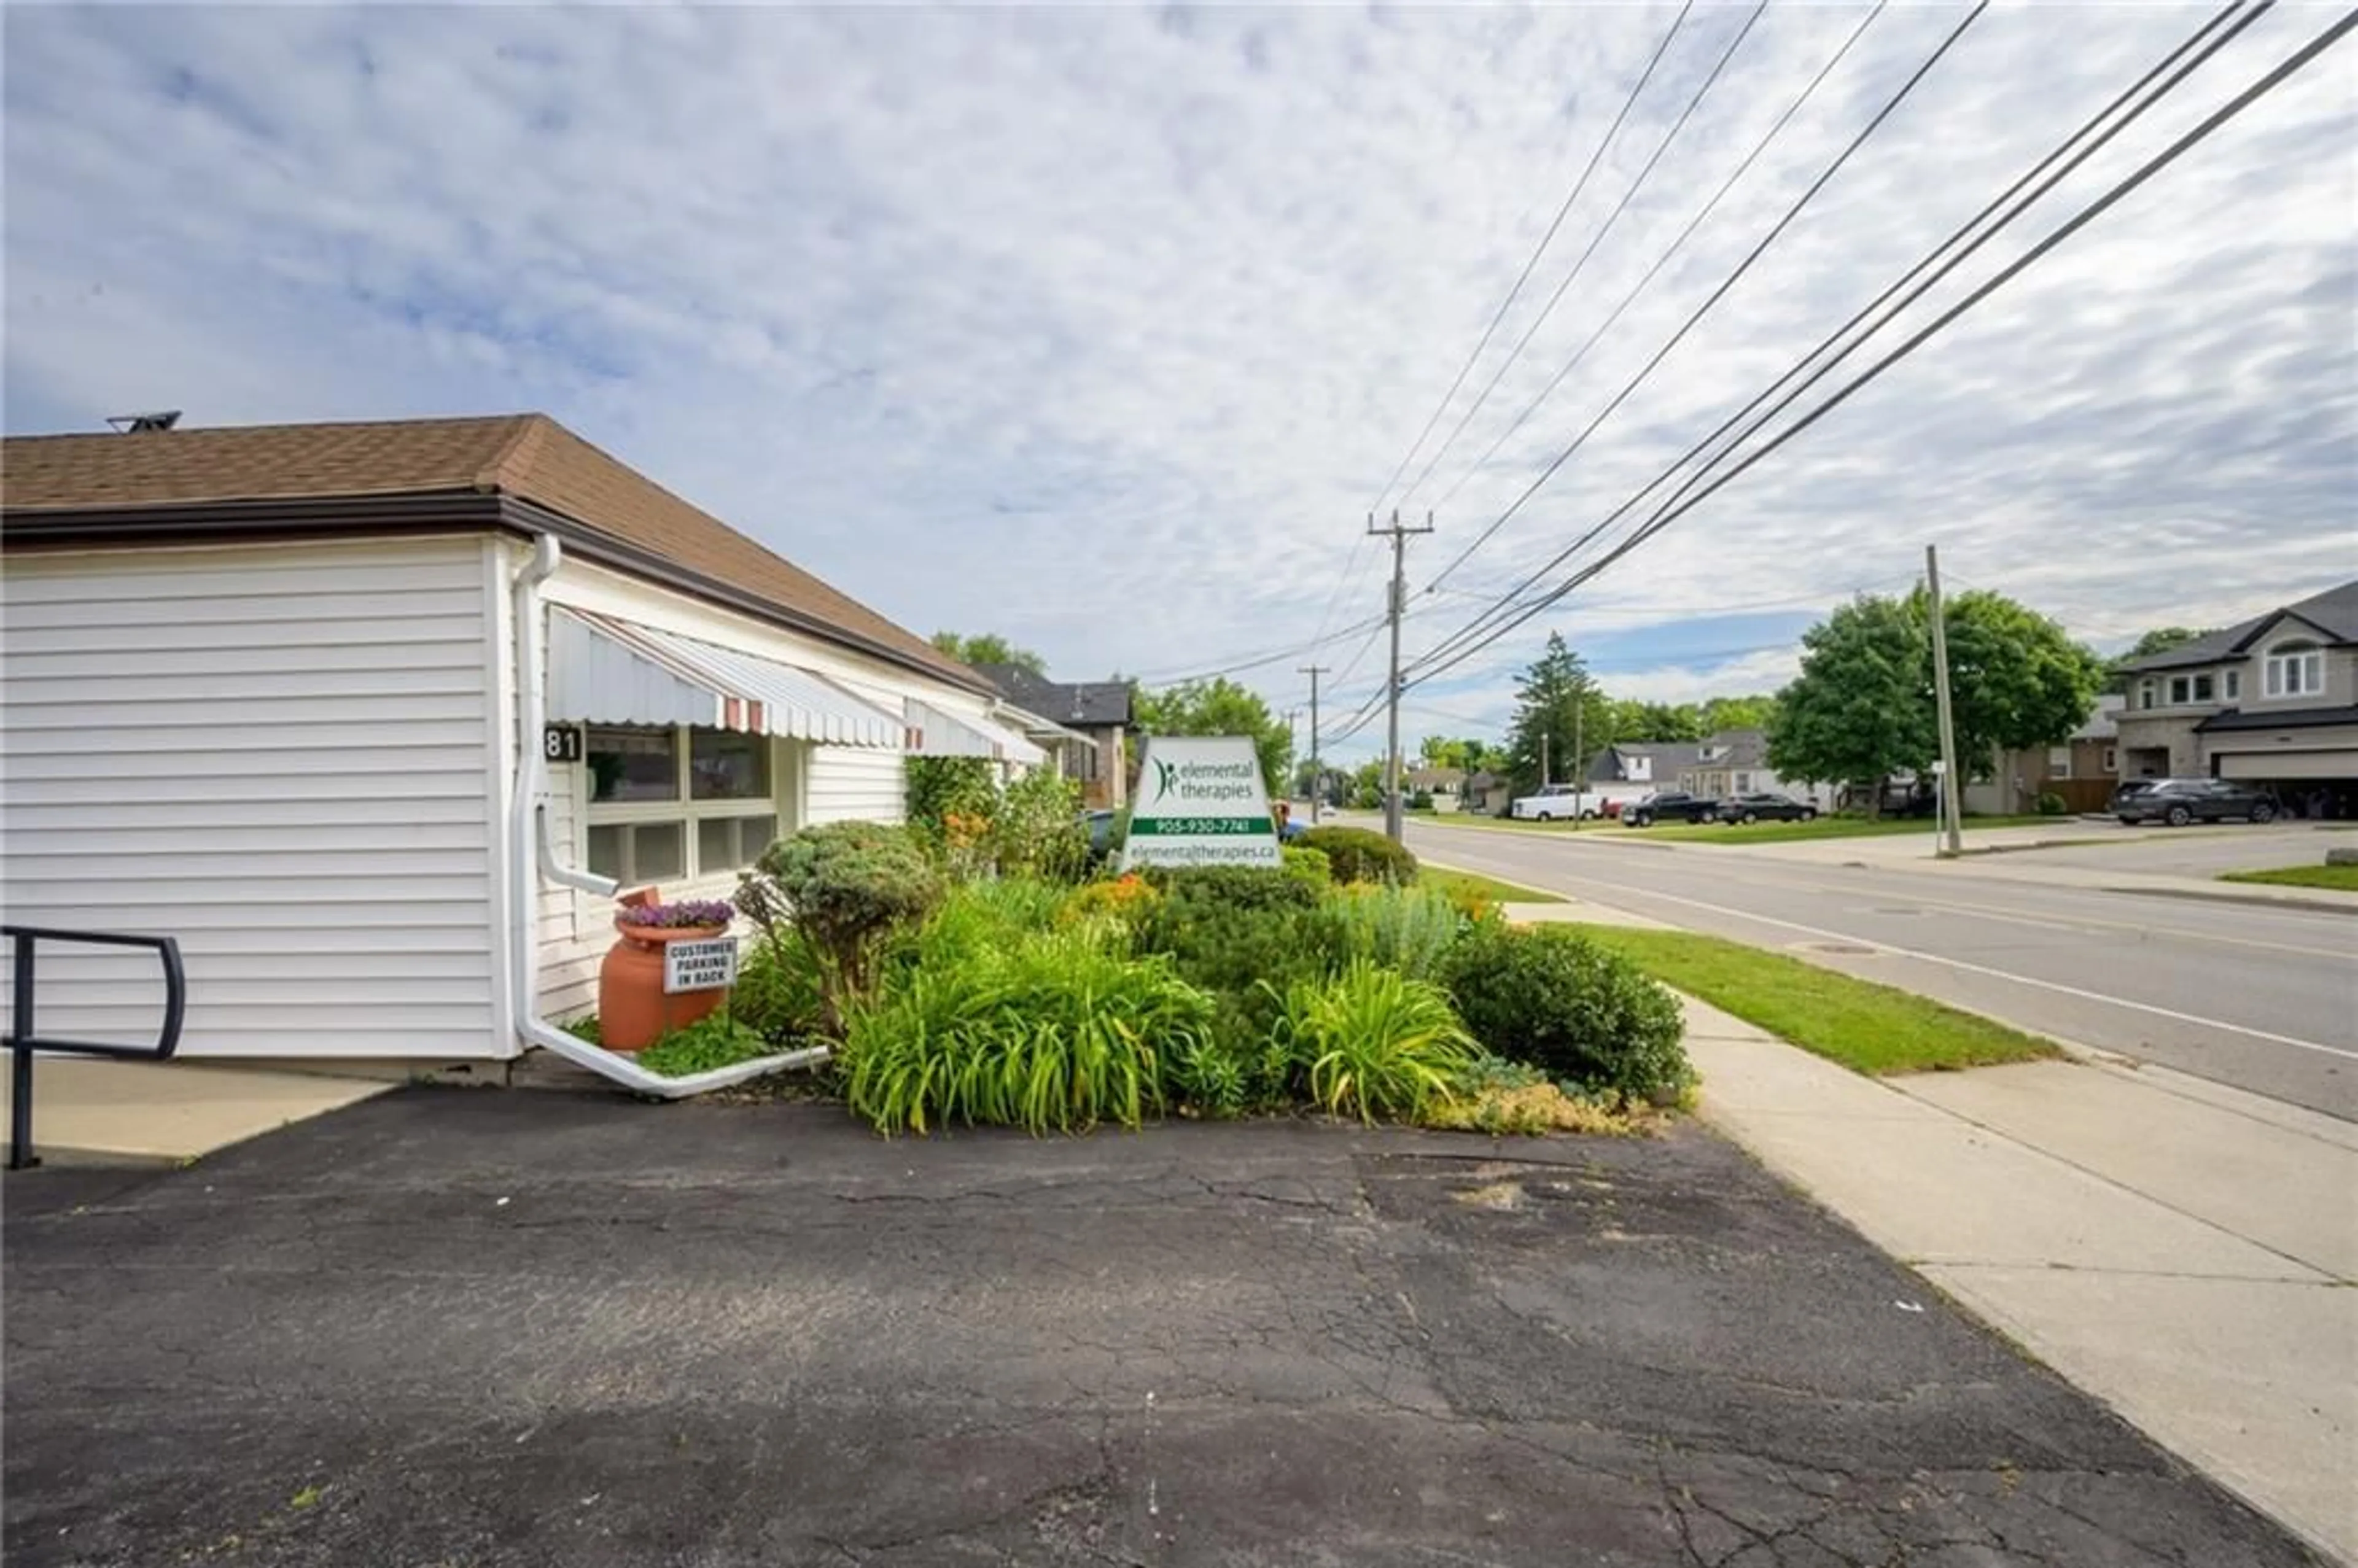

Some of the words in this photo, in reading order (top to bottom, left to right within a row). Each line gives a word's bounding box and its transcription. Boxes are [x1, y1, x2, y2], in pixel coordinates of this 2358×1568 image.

[548, 730, 574, 758] 81
[1180, 761, 1253, 778] elemental
[1181, 783, 1253, 801] therapies
[1156, 820, 1250, 833] 905-930-7741
[1130, 845, 1275, 860] elementaltherapies.ca
[671, 942, 731, 958] CUSTOMER
[677, 956, 728, 971] PARKING
[679, 974, 691, 986] IN
[695, 971, 725, 983] BACK
